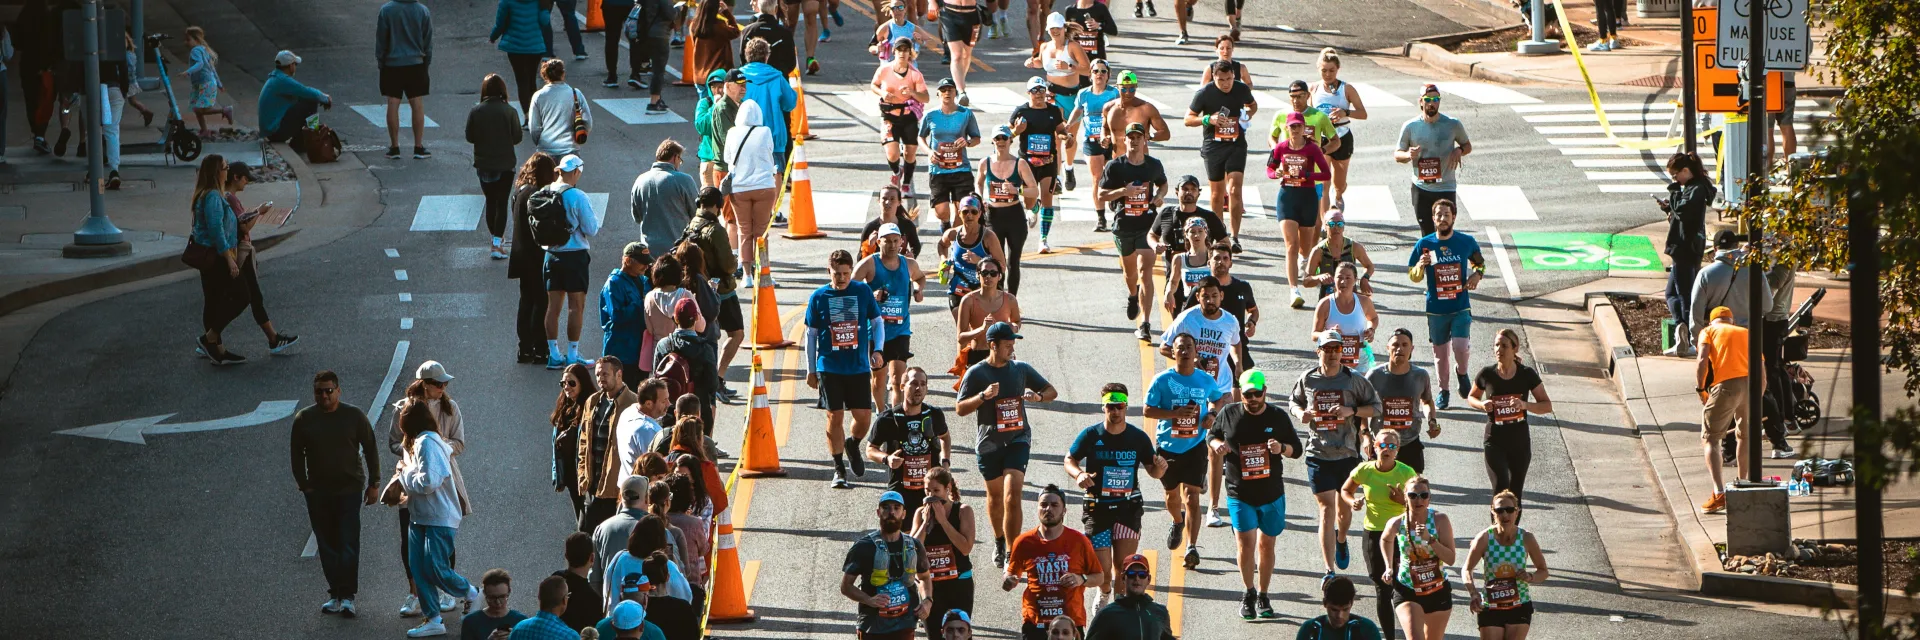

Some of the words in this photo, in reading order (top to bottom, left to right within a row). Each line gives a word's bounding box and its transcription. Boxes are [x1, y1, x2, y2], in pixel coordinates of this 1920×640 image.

[1730, 26, 1749, 39] MA
[1769, 27, 1795, 40] USE
[1722, 48, 1746, 60] FUL
[1767, 49, 1801, 62] LANE
[1438, 274, 1458, 282] 14142
[881, 306, 902, 314] 20681
[1200, 327, 1222, 341] 1907
[1245, 457, 1264, 466] 2338
[931, 557, 950, 566] 2759
[1036, 560, 1069, 574] NASH
[1038, 573, 1061, 583] VILL
[1491, 588, 1515, 599] 13639
[1039, 607, 1063, 615] 14126
